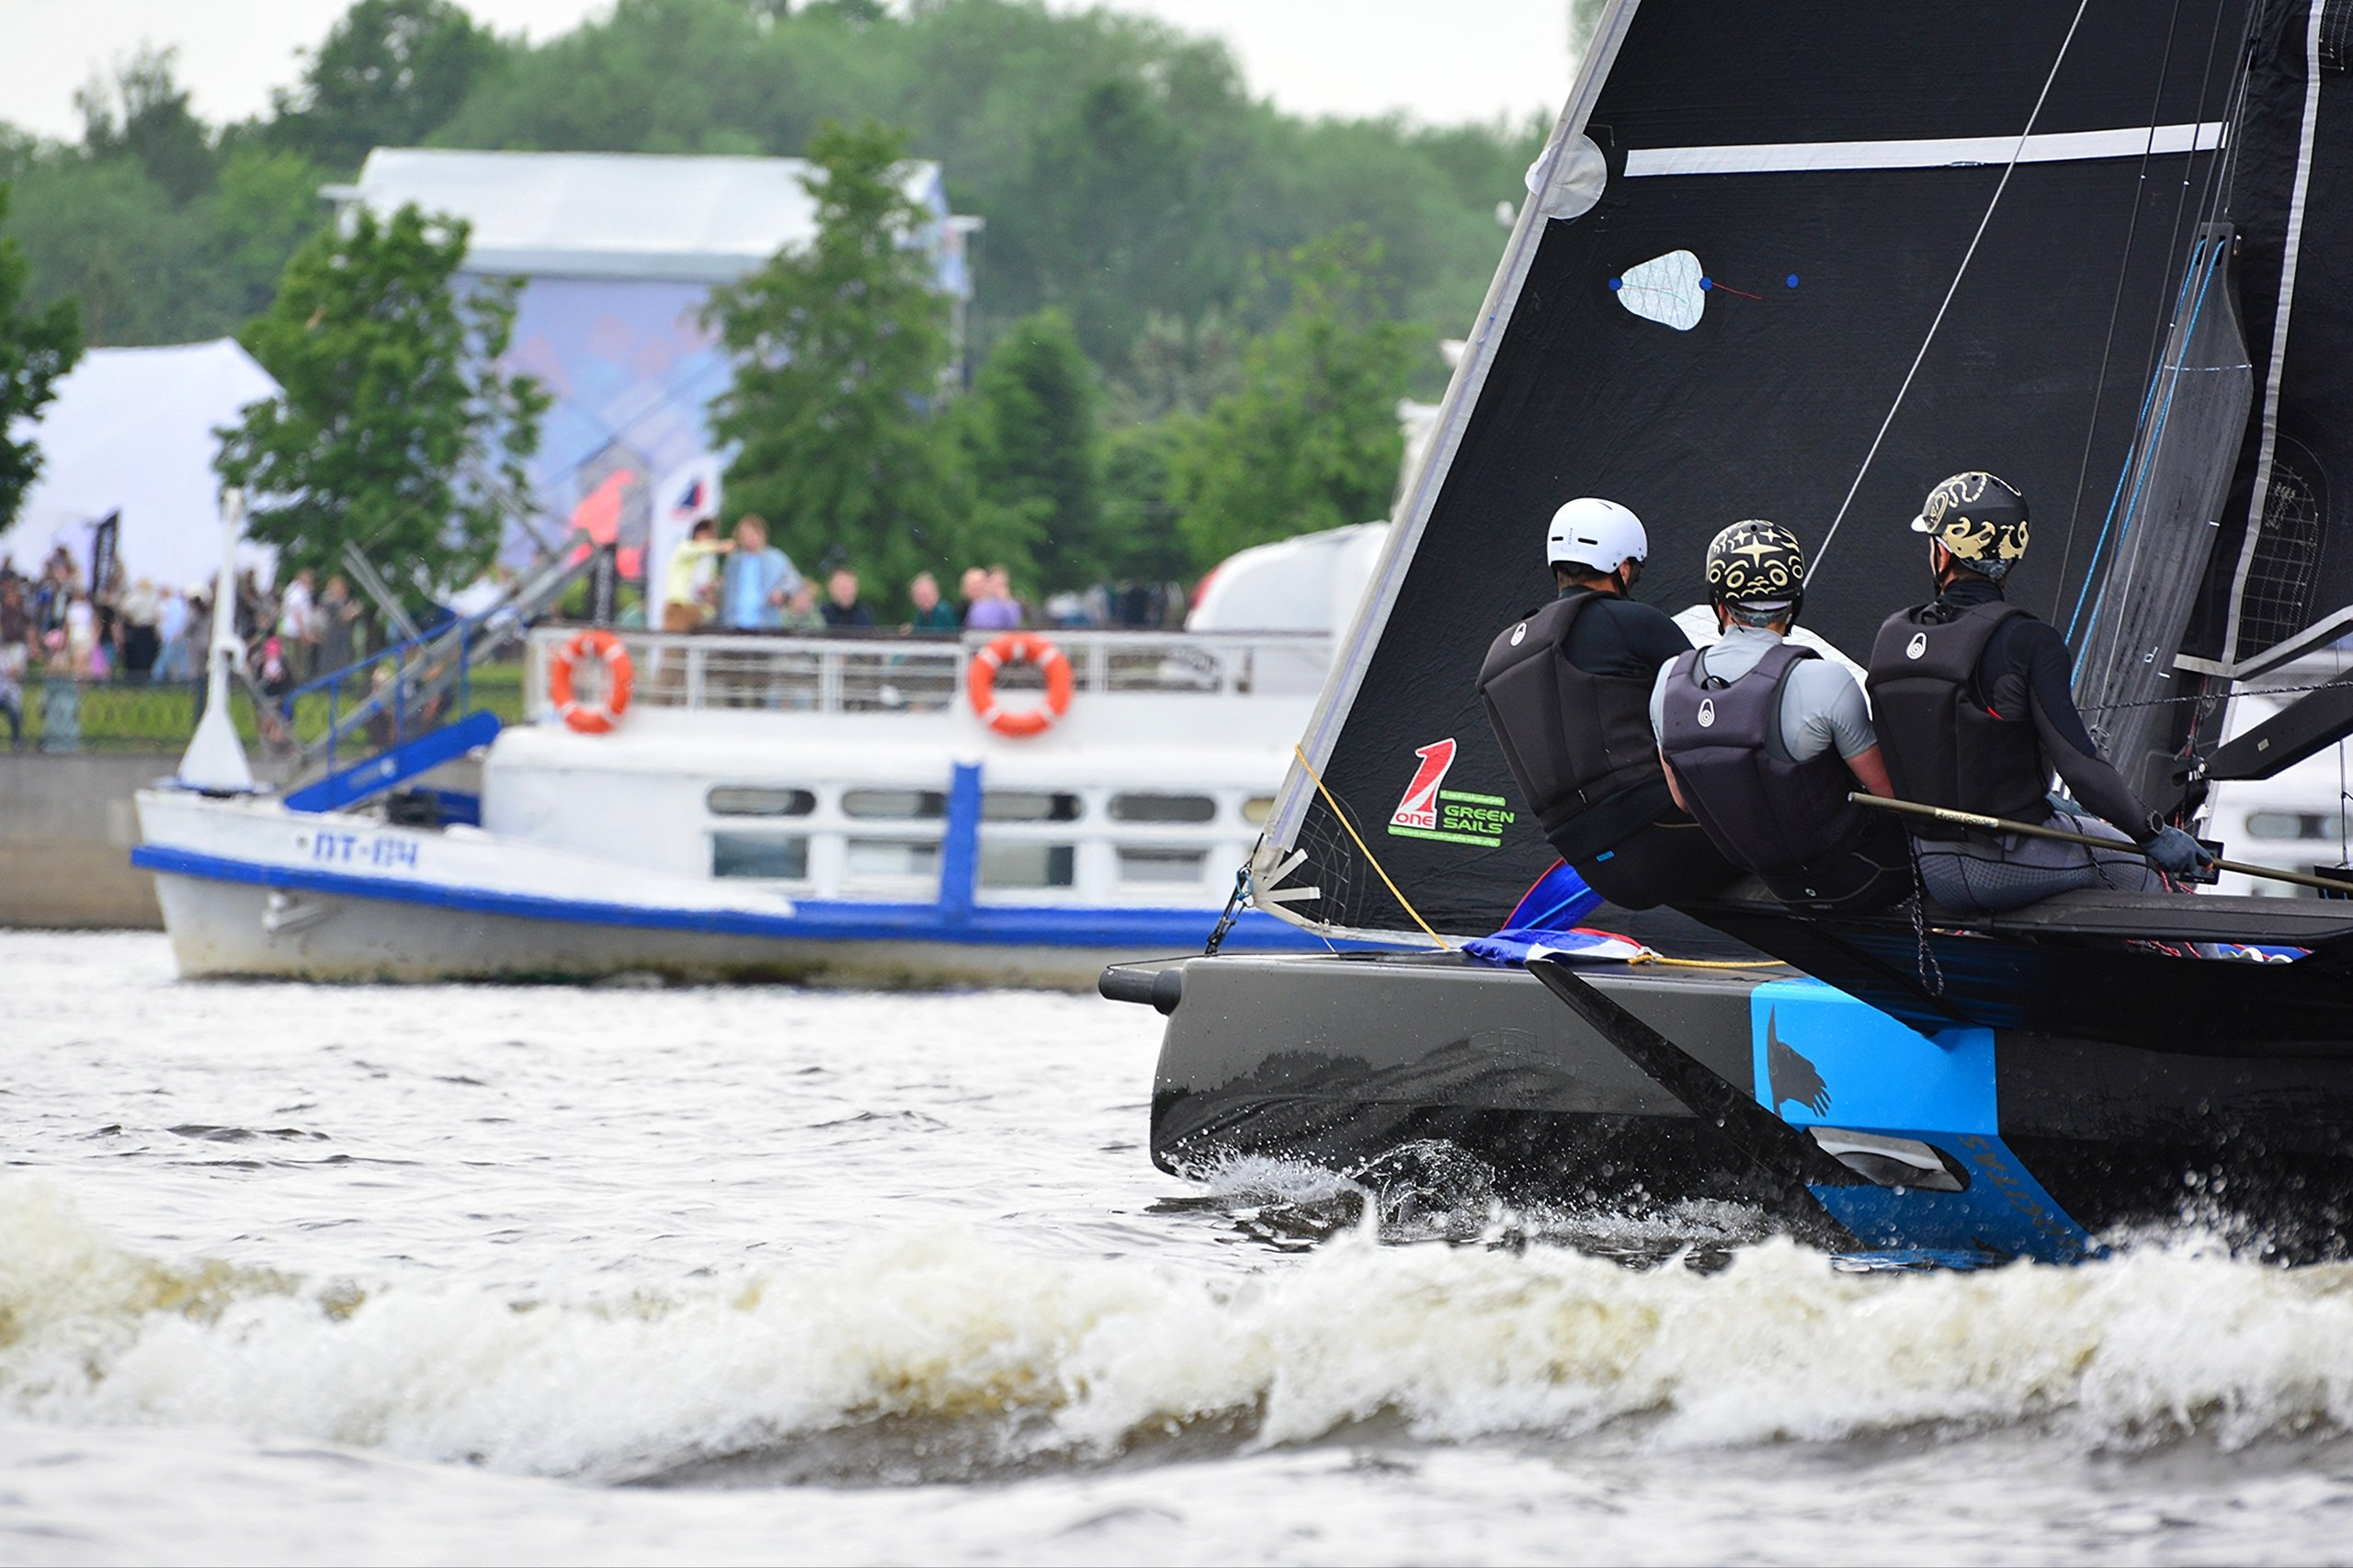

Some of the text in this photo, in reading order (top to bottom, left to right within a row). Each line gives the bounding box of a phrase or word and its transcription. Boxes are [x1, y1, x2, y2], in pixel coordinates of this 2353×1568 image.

[1395, 812, 1434, 826] ONE
[1444, 805, 1515, 824] GREEN
[1443, 817, 1504, 835] SAILS
